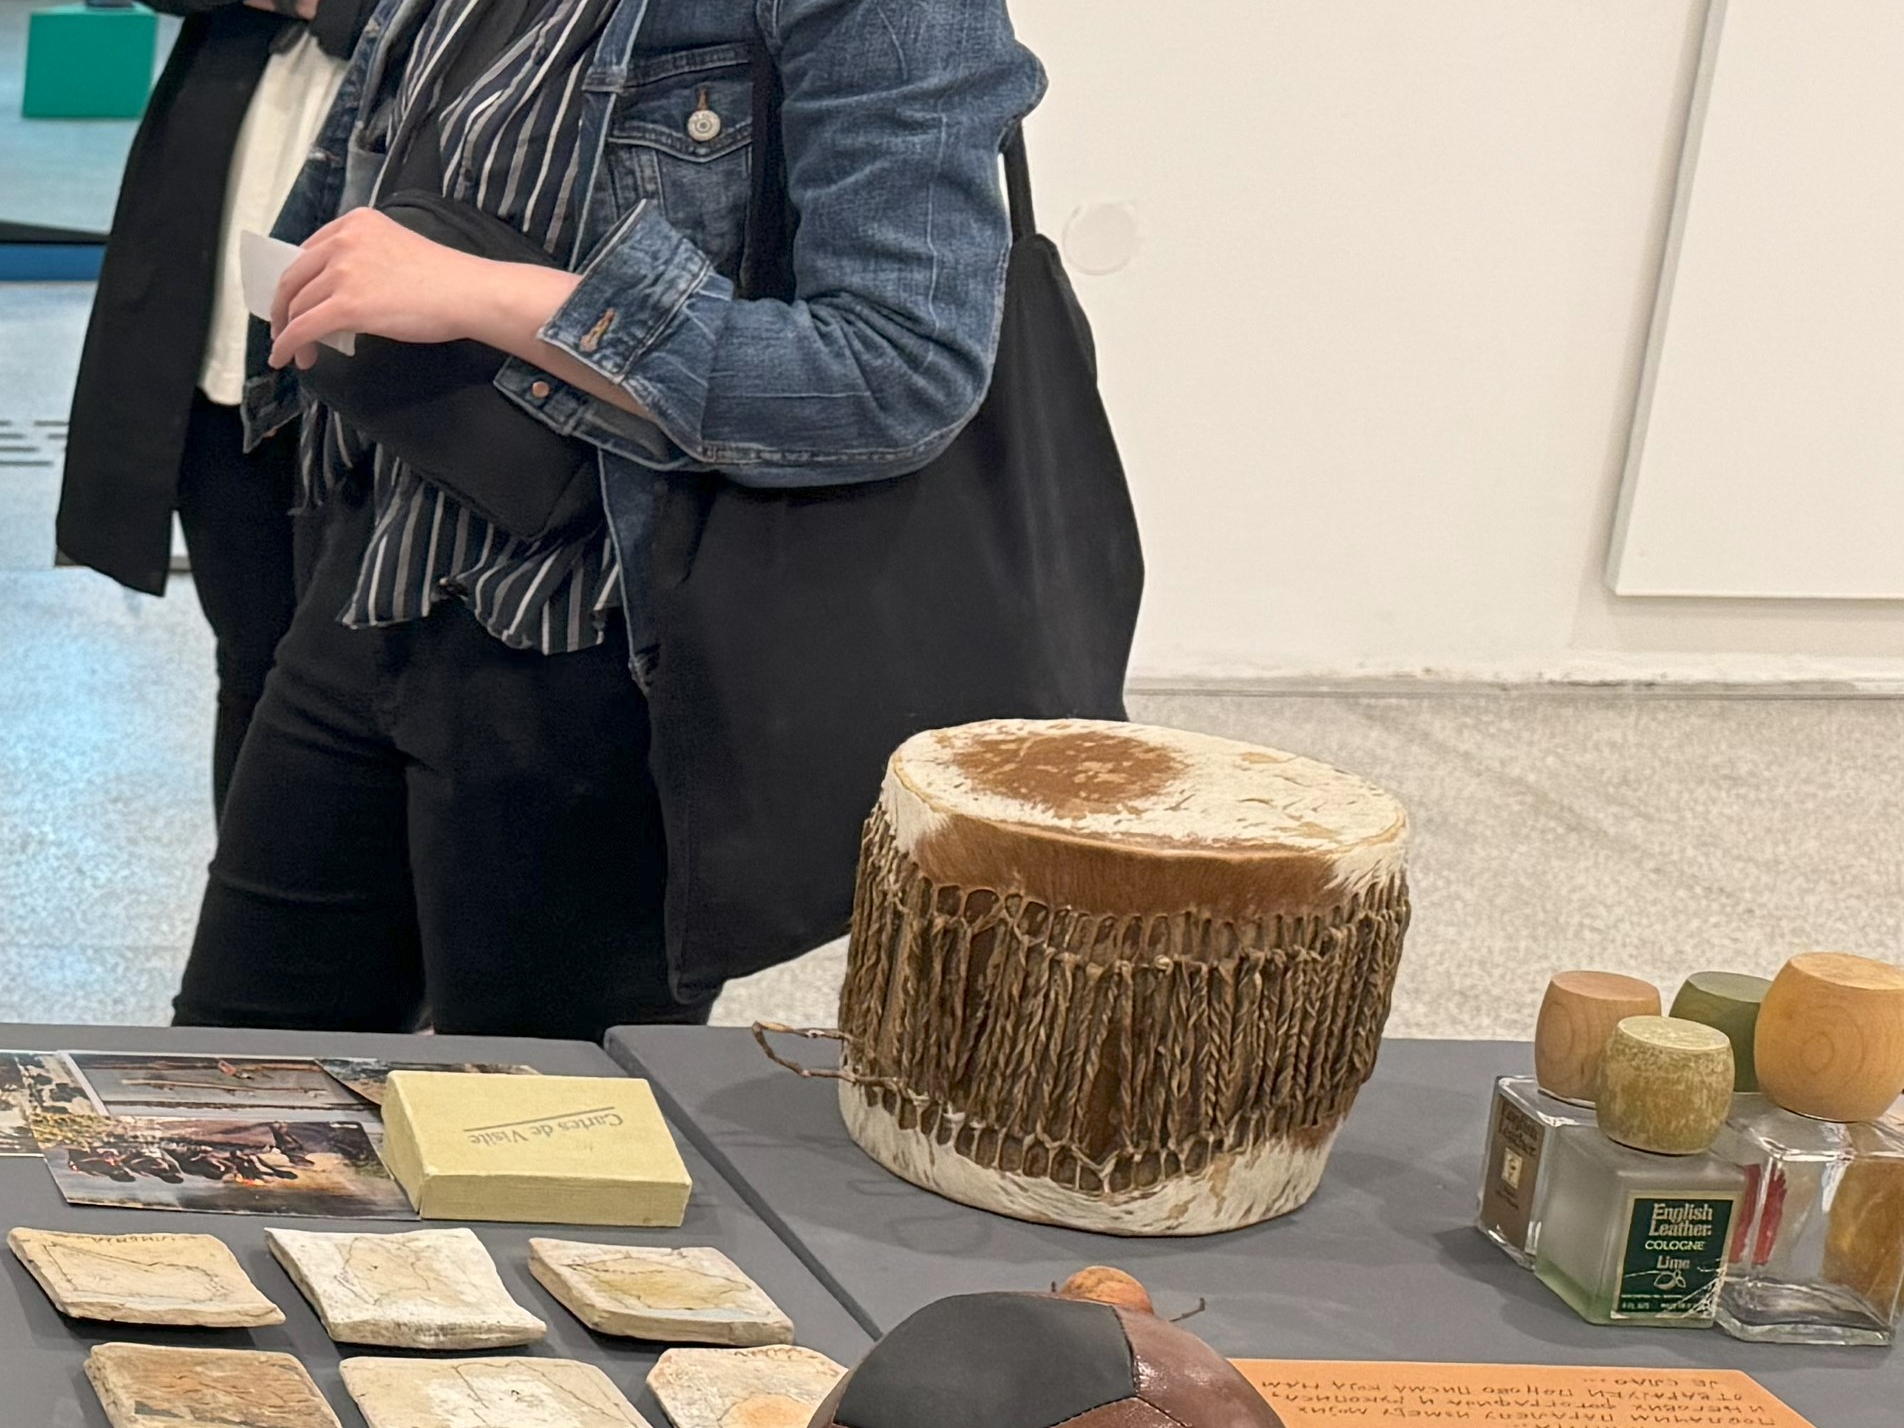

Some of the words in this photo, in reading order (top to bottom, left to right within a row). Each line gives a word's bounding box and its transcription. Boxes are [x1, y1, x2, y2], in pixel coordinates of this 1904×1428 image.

[558, 1113, 623, 1131] Cartes
[467, 1129, 529, 1146] Visite
[528, 1124, 553, 1138] de
[1652, 1203, 1713, 1223] English
[1644, 1240, 1706, 1250] COLOGNE
[1656, 1255, 1691, 1270] Lime
